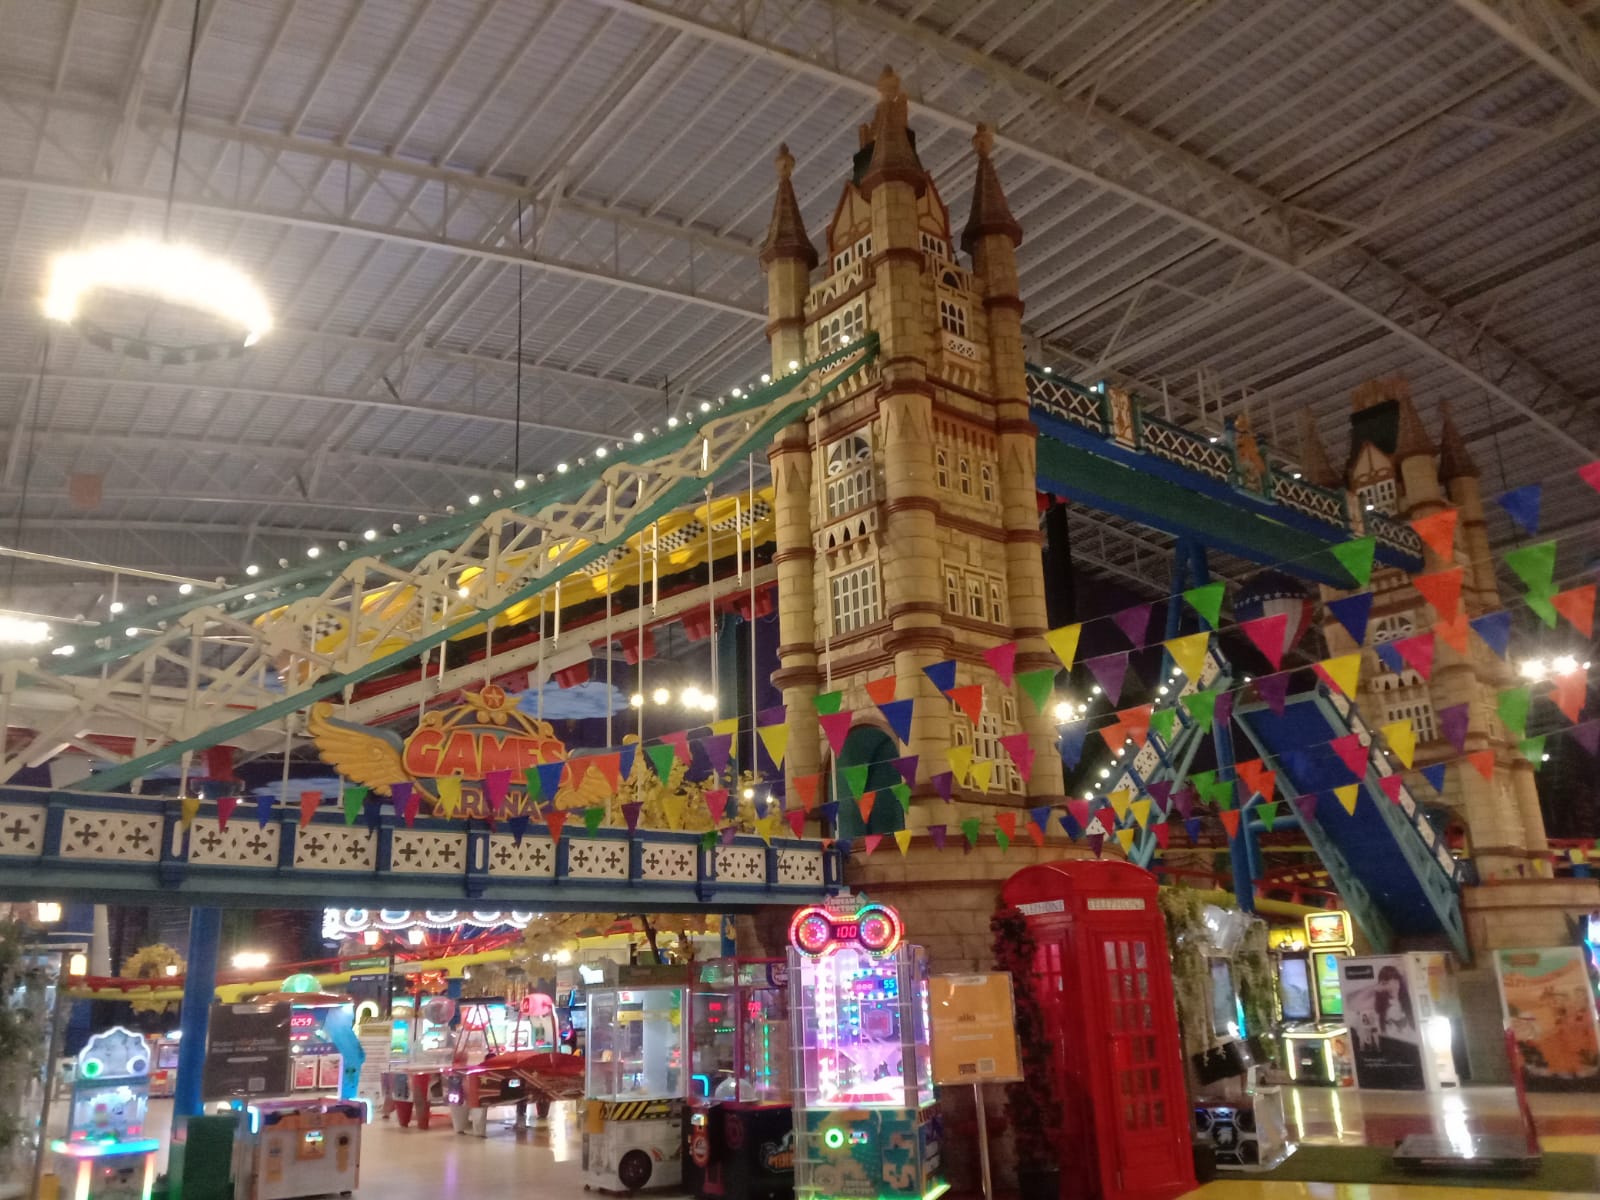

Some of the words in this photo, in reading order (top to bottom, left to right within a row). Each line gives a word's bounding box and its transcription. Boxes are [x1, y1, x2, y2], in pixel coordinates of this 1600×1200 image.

[403, 727, 571, 789] GAMES
[433, 787, 544, 822] ARNA
[836, 925, 857, 938] 100
